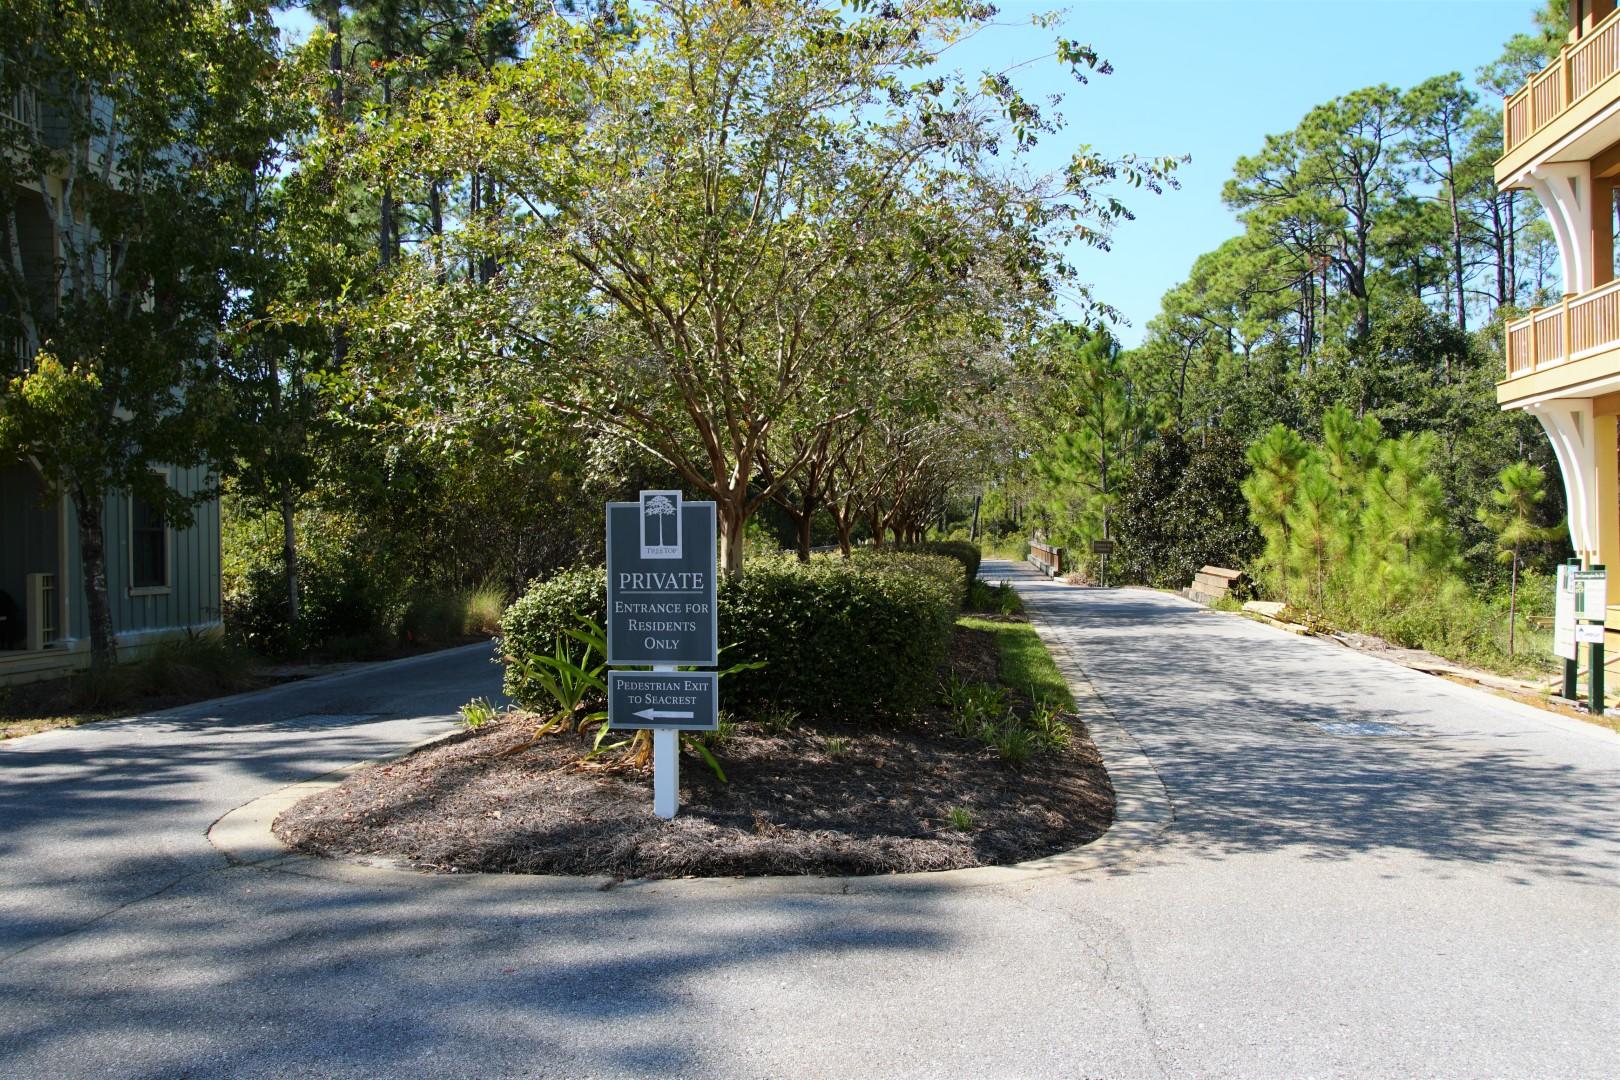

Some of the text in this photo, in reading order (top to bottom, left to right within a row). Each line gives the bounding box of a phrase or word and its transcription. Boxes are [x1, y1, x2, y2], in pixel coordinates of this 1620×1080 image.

[620, 572, 704, 589] PRIVATE
[615, 601, 709, 614] ENTRANCE FOR
[628, 619, 697, 632] RESIDENTS
[644, 636, 680, 650] ONLY
[616, 679, 709, 691] PEDESTRIAN EXIT
[628, 693, 697, 705] TO SEACREST
